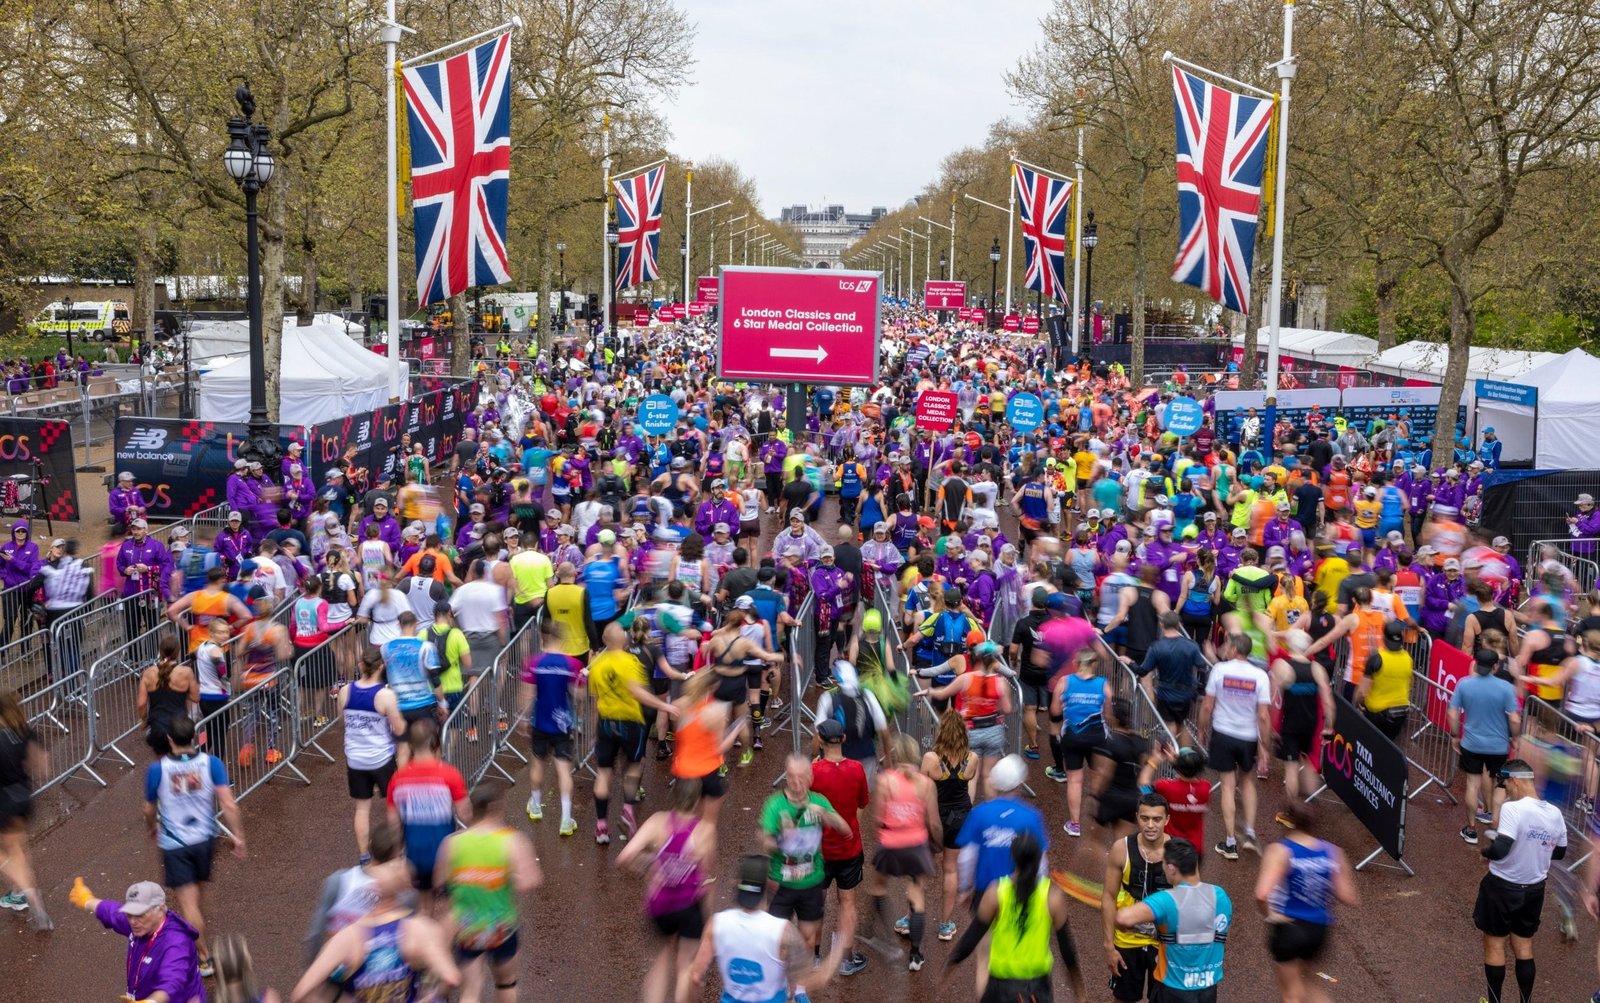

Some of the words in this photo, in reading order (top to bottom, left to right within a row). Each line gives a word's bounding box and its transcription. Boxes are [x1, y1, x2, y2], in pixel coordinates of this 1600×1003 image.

[839, 280, 854, 290] tcs
[741, 307, 782, 318] London
[785, 309, 831, 320] Classics
[834, 311, 856, 321] and
[733, 318, 741, 329] 6
[743, 319, 765, 330] Star
[768, 320, 803, 331] Medal
[806, 321, 863, 333] Collection
[923, 402, 951, 410] CLASSICS
[647, 411, 669, 419] 6-star
[918, 415, 954, 423] COLLECTION
[1012, 417, 1037, 426] finisher
[1015, 410, 1035, 418] 6-star
[383, 415, 397, 442] tcs
[645, 420, 671, 428] finisher
[0, 434, 31, 461] cs
[321, 433, 339, 464] tcs
[117, 452, 134, 460] new
[136, 451, 174, 461] balance
[137, 483, 171, 509] cs
[1436, 659, 1457, 703] tc
[1356, 740, 1373, 768] TATA
[1354, 758, 1396, 809] CONSULTANCY
[1353, 774, 1379, 810] SERVICES
[1184, 971, 1216, 988] NICK
